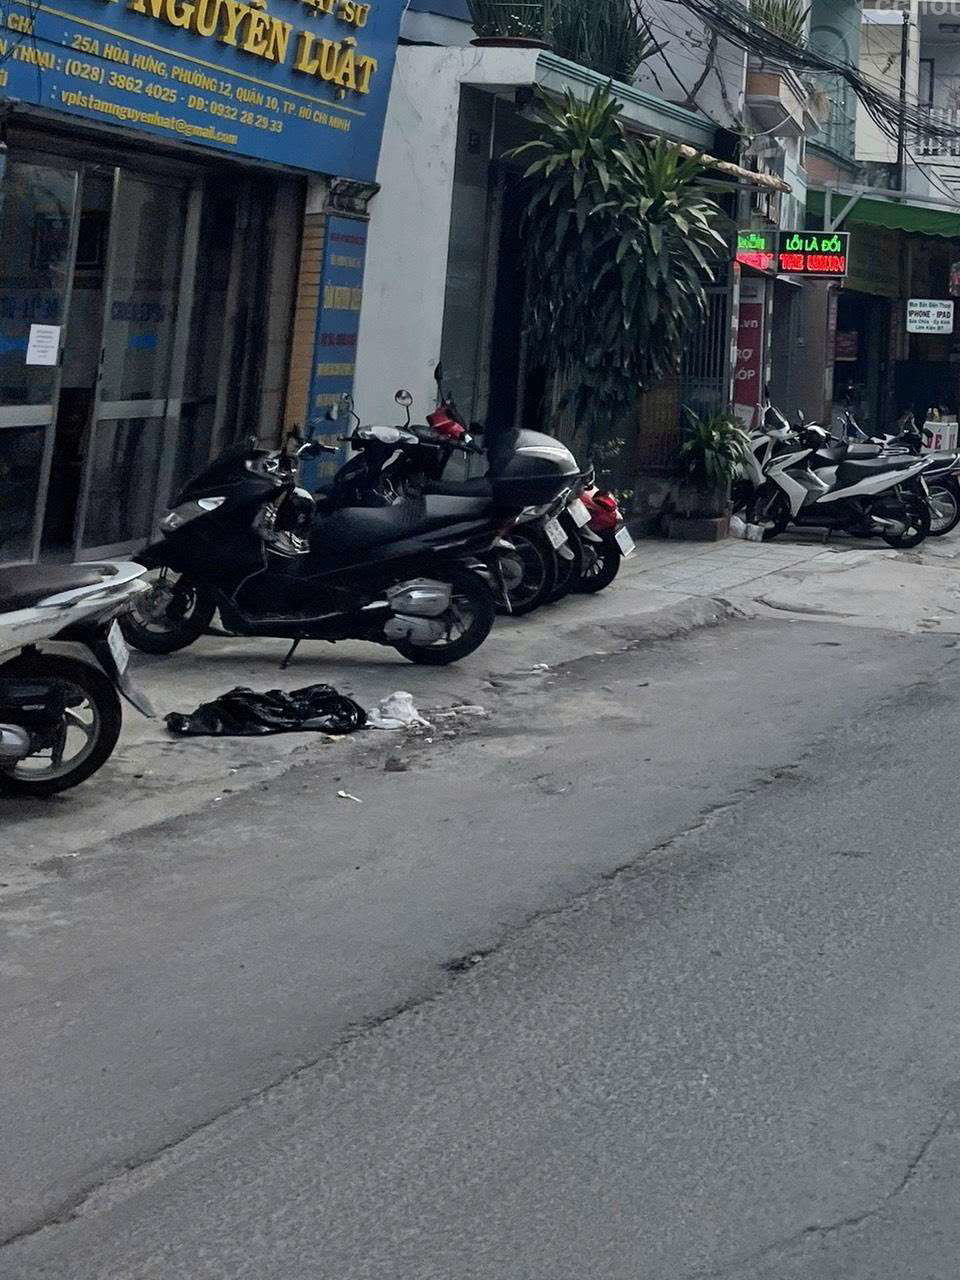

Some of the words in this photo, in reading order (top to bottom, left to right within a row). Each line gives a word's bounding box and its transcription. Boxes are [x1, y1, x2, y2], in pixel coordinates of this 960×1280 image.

[71, 33, 99, 55] 25A
[102, 41, 130, 65] HÒA
[296, 30, 379, 100] LUẬT
[64, 58, 105, 84] (028)
[108, 71, 144, 94] 3862
[144, 83, 178, 104] 4025
[210, 100, 239, 120] 0932
[804, 236, 819, 252] LÀ
